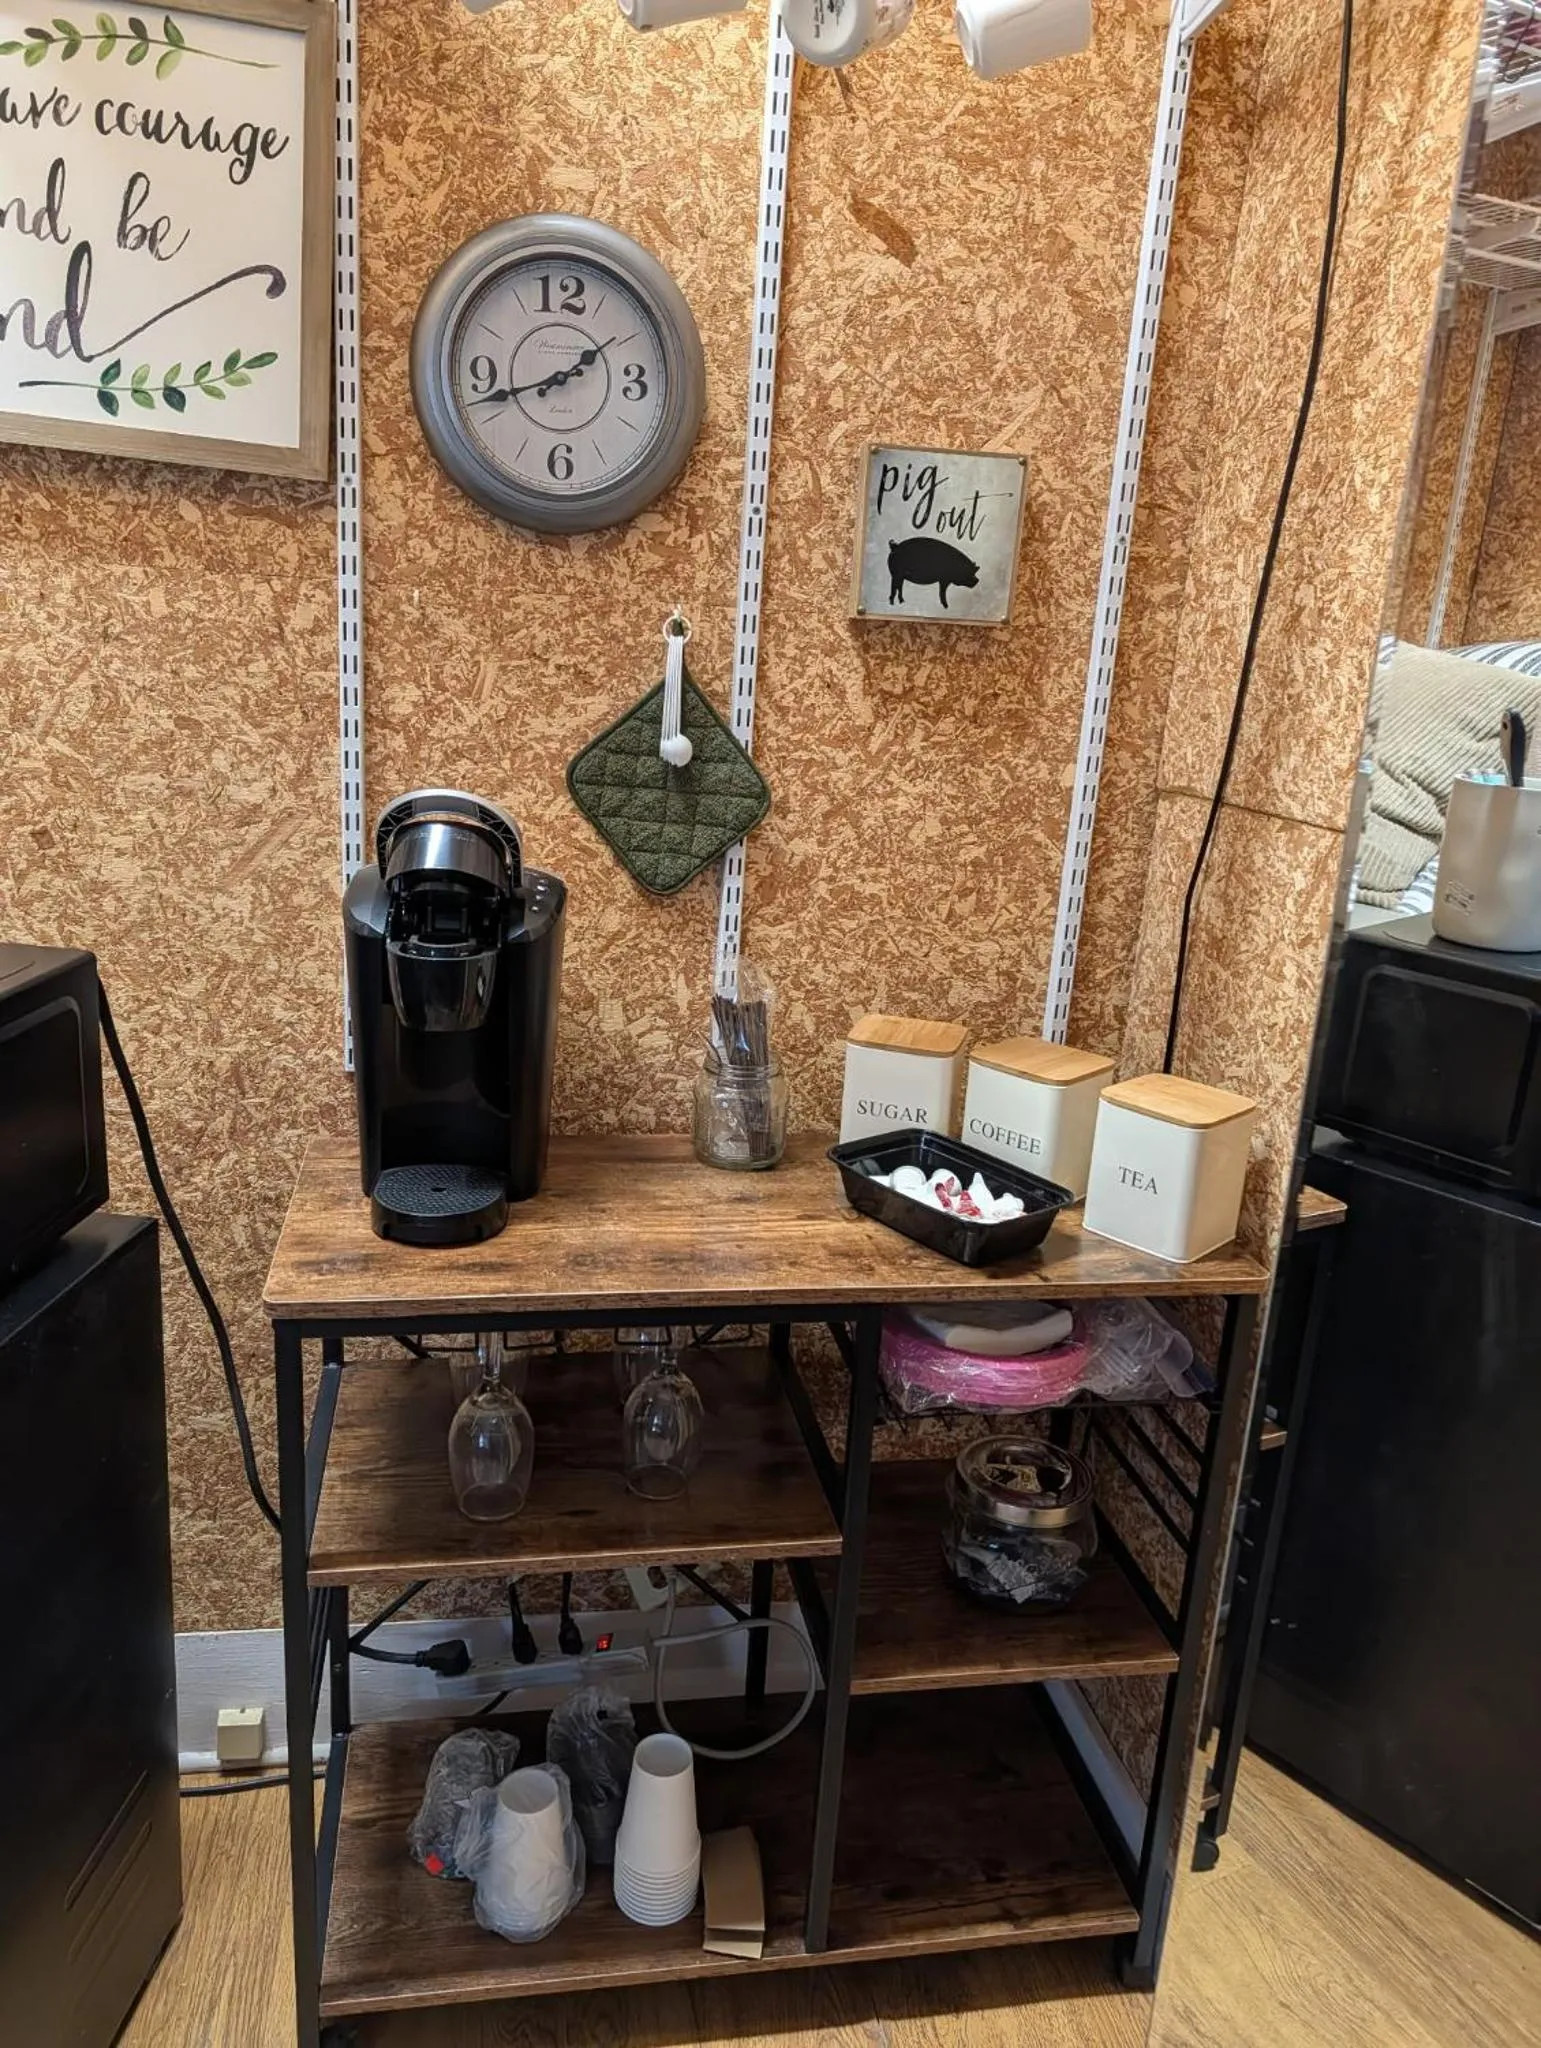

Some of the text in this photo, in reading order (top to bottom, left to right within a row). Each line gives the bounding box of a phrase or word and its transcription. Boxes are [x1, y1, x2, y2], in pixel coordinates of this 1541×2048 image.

[95, 98, 289, 185] courage
[117, 172, 190, 261] be
[533, 274, 587, 315] 12
[469, 355, 648, 401] 9 3
[547, 443, 574, 480] 6
[877, 463, 949, 529] pig
[936, 490, 1014, 541] out
[856, 1099, 928, 1124] SUGAR
[969, 1118, 1041, 1155] COFFEE
[1118, 1165, 1158, 1195] TEA
